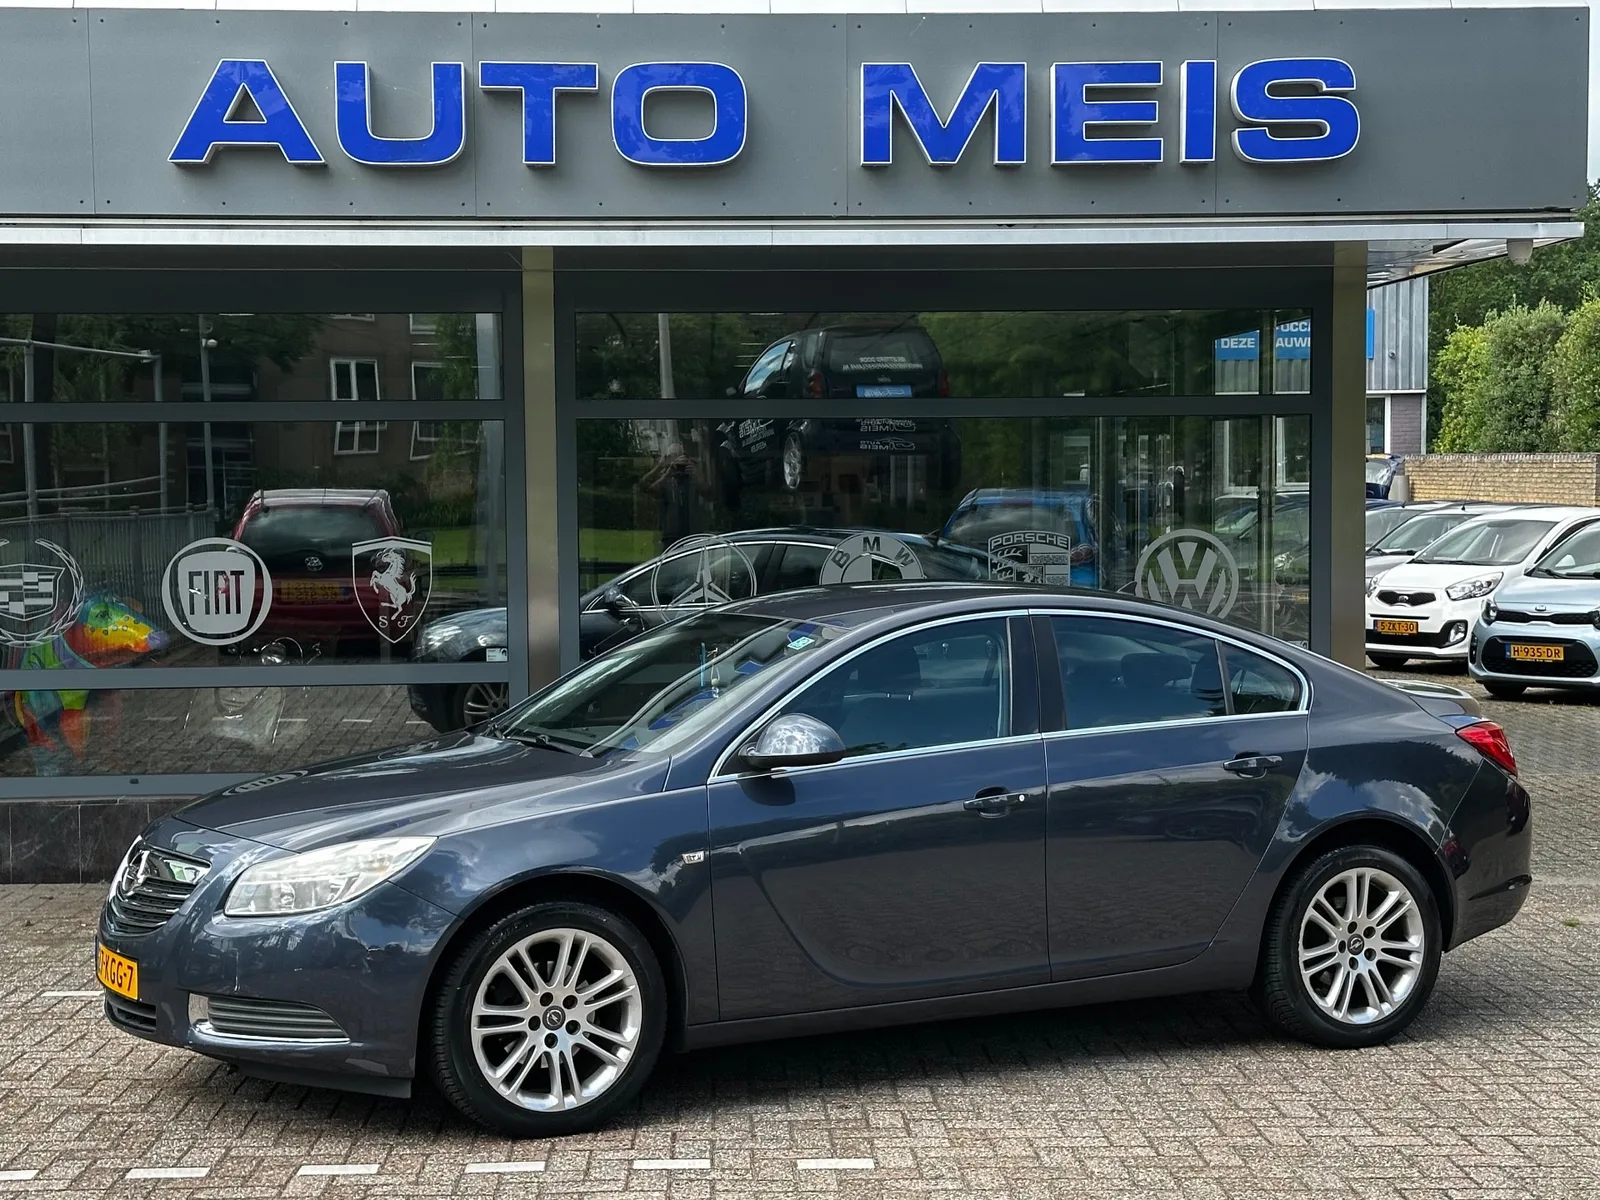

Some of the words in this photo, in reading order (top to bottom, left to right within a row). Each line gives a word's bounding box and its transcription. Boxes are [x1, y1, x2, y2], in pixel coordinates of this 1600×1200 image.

[167, 58, 749, 168] AUTO
[860, 57, 1361, 167] MEIS
[1220, 337, 1256, 349] DEZE
[830, 536, 915, 569] BMW
[991, 533, 1068, 550] PORSCHE
[188, 570, 245, 615] FIAT
[1513, 646, 1561, 659] H-935-DR
